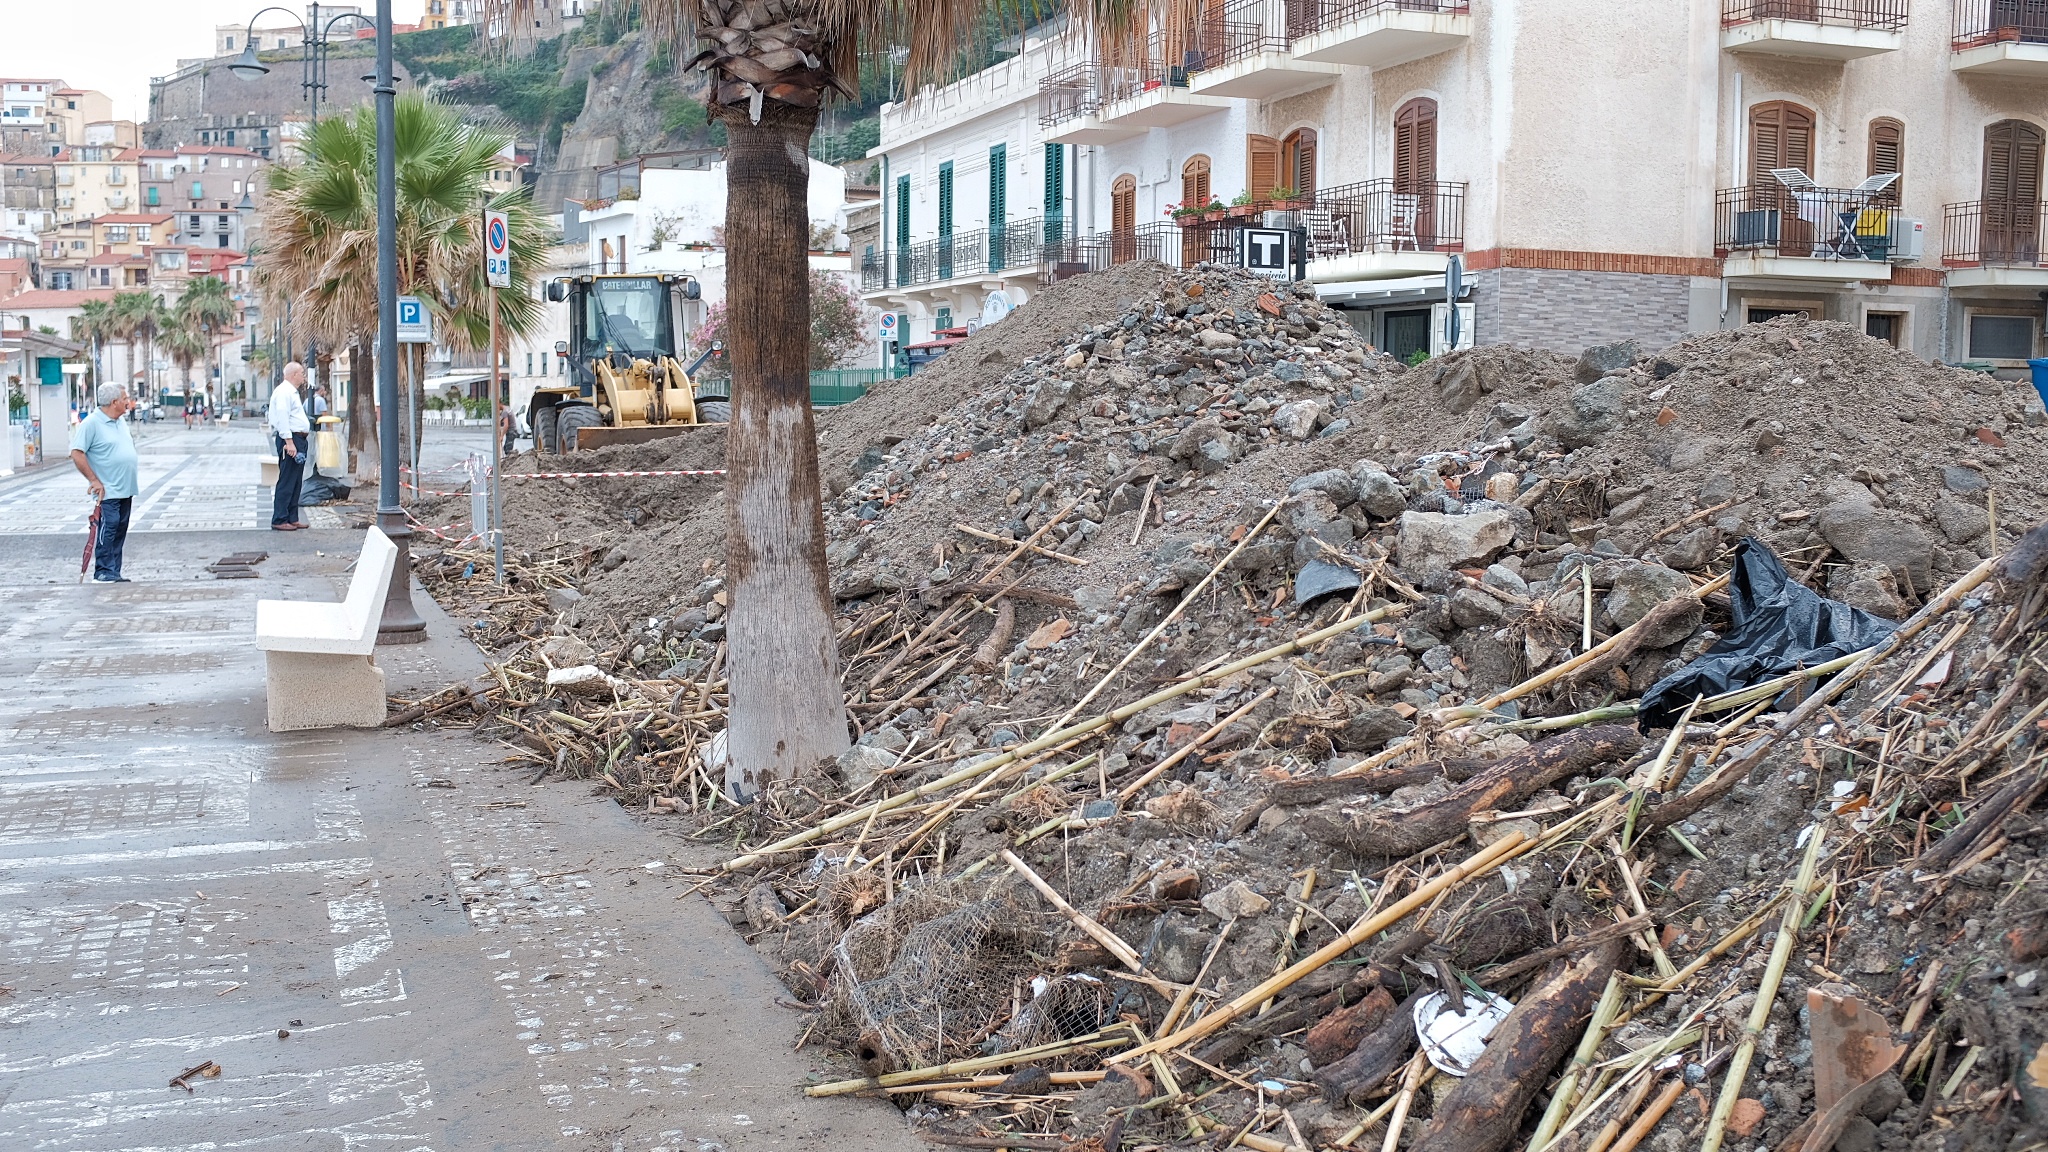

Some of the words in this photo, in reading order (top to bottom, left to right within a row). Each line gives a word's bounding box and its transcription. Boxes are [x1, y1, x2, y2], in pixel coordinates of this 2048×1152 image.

[1252, 234, 1280, 265] T
[602, 281, 652, 290] CATERPILLAR
[404, 305, 416, 321] P
